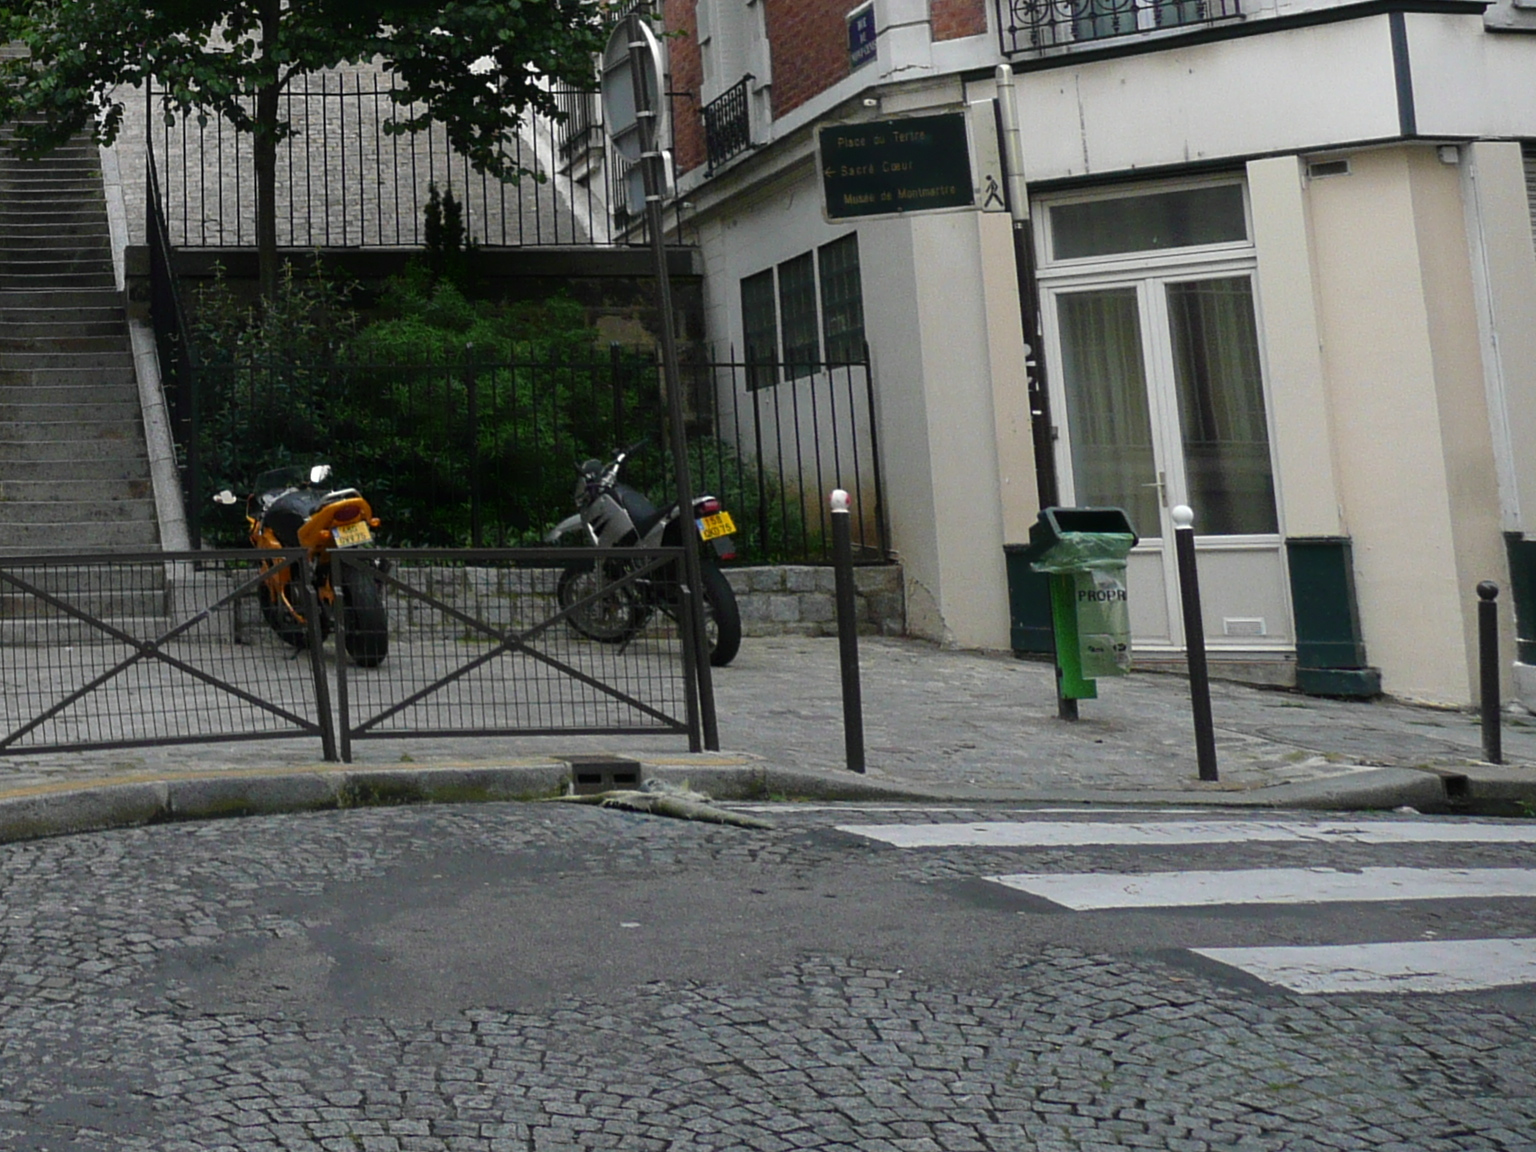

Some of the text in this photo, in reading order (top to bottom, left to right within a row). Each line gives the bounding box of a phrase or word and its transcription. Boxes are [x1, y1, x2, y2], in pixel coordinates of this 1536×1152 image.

[837, 136, 866, 148] Place
[892, 130, 926, 143] Tertre
[880, 190, 892, 201] de
[897, 184, 957, 199] Montmartre
